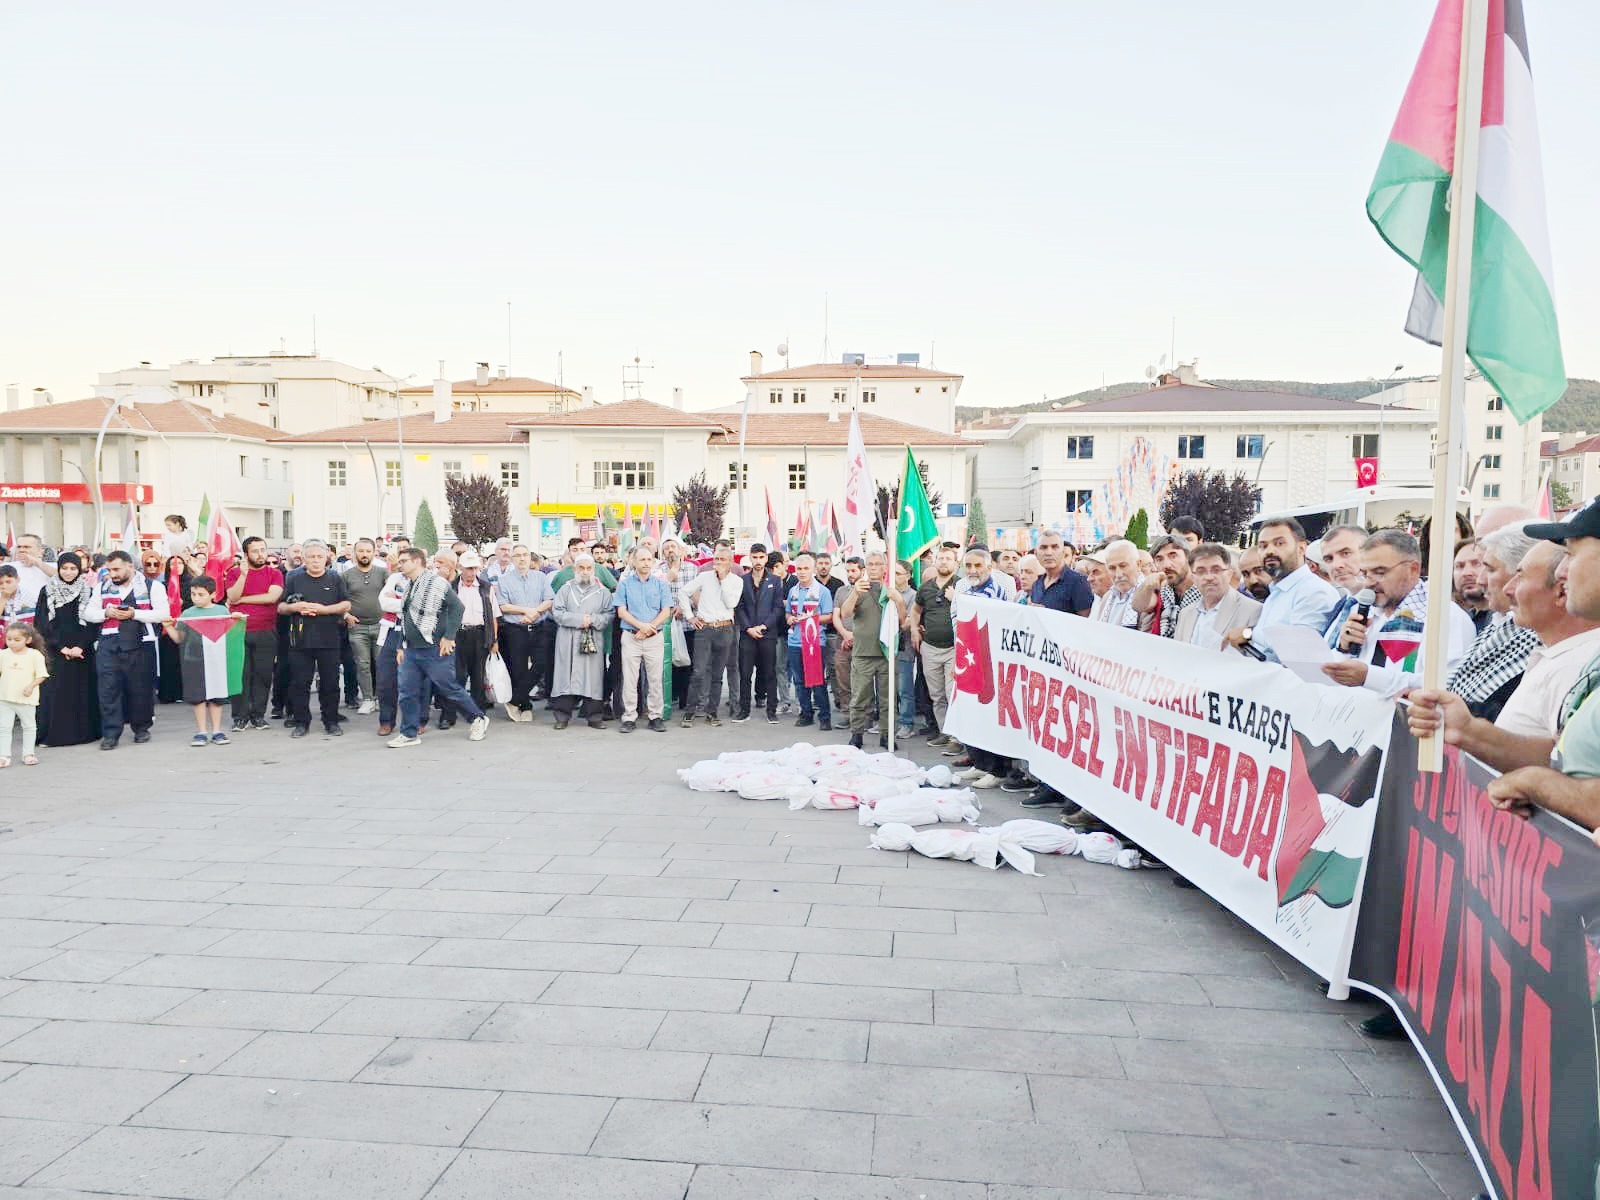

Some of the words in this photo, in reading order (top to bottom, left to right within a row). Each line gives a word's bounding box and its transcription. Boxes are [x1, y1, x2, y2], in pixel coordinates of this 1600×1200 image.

[1, 487, 27, 498] Ziraat
[27, 487, 61, 498] Bankası
[998, 661, 1105, 778] KİRESEL
[1113, 706, 1287, 882] İNTİFADA
[1001, 627, 1036, 658] KATİL
[1039, 638, 1062, 667] ABD
[1227, 695, 1291, 753] KARŞI
[1394, 825, 1456, 1036] IN
